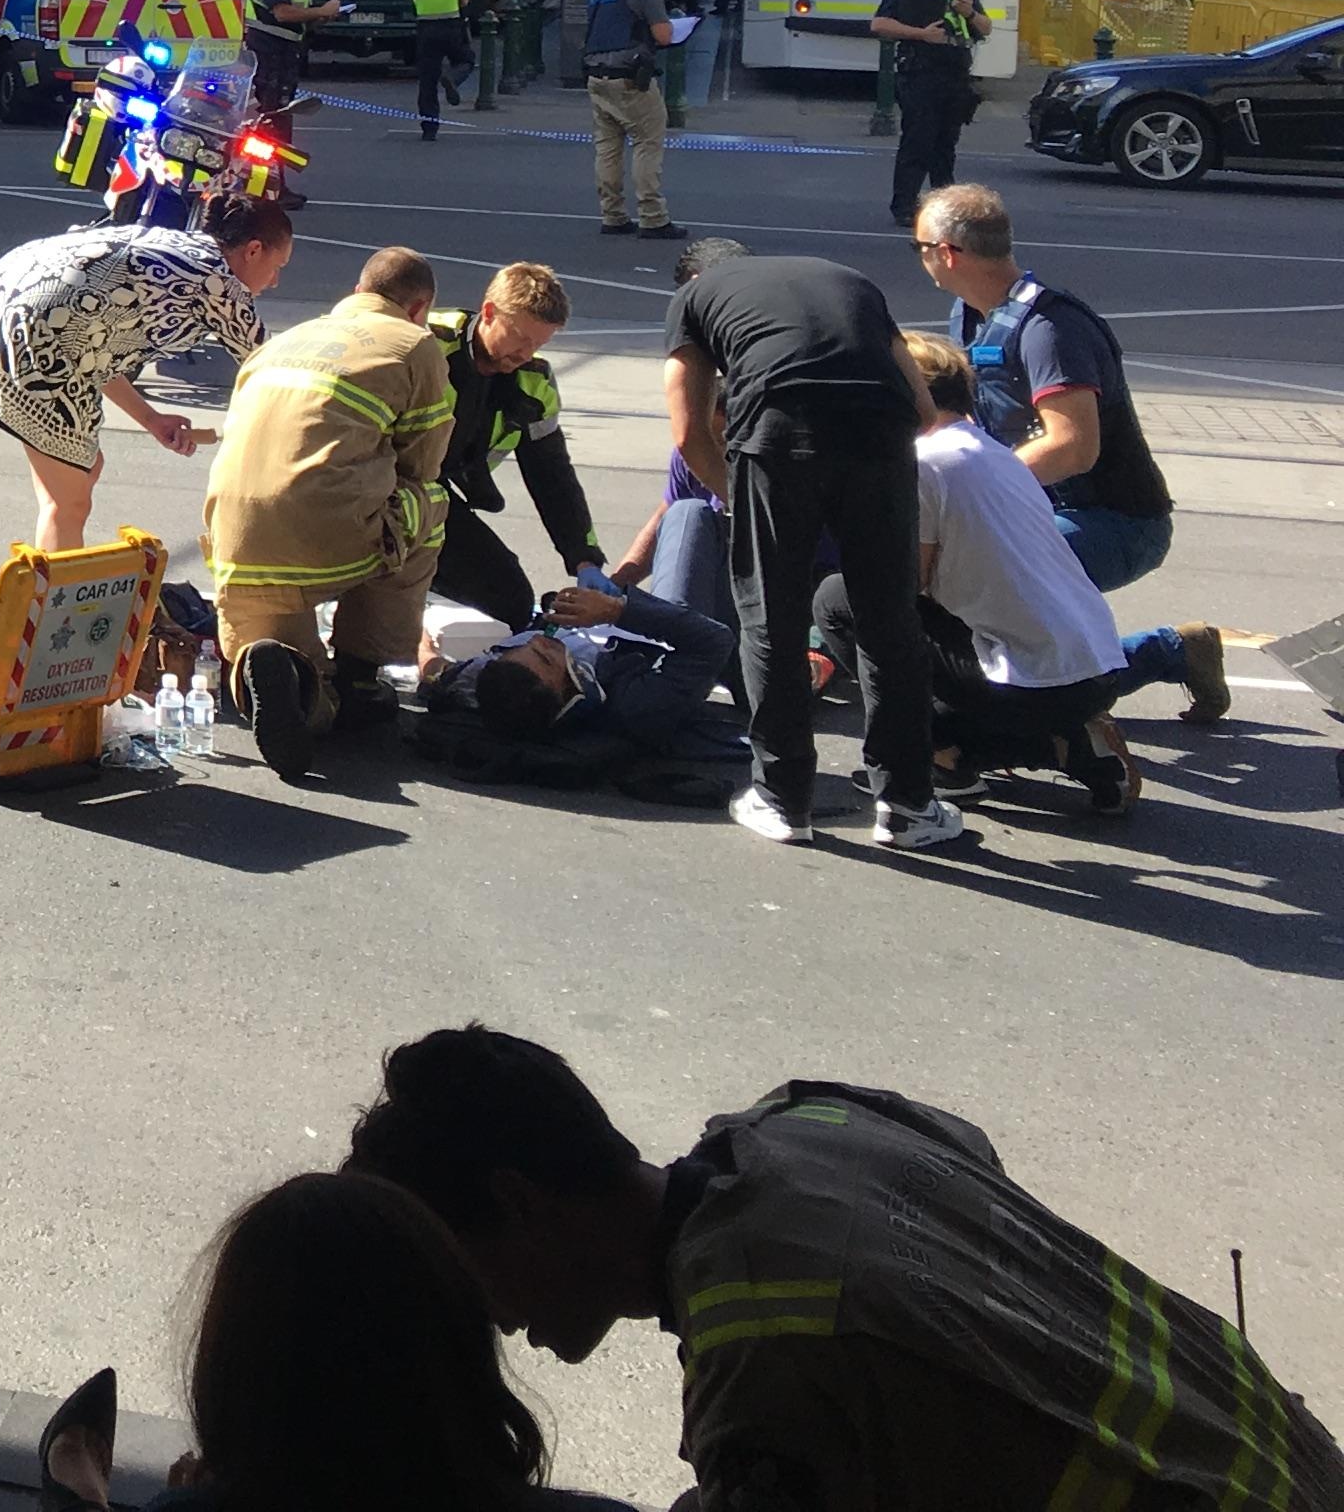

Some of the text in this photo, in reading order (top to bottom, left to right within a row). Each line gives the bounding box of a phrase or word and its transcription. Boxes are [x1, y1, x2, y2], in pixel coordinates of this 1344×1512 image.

[76, 578, 136, 602] CAR 041
[47, 658, 95, 680] OXYGEN
[21, 675, 109, 704] RESUSCITATOR
